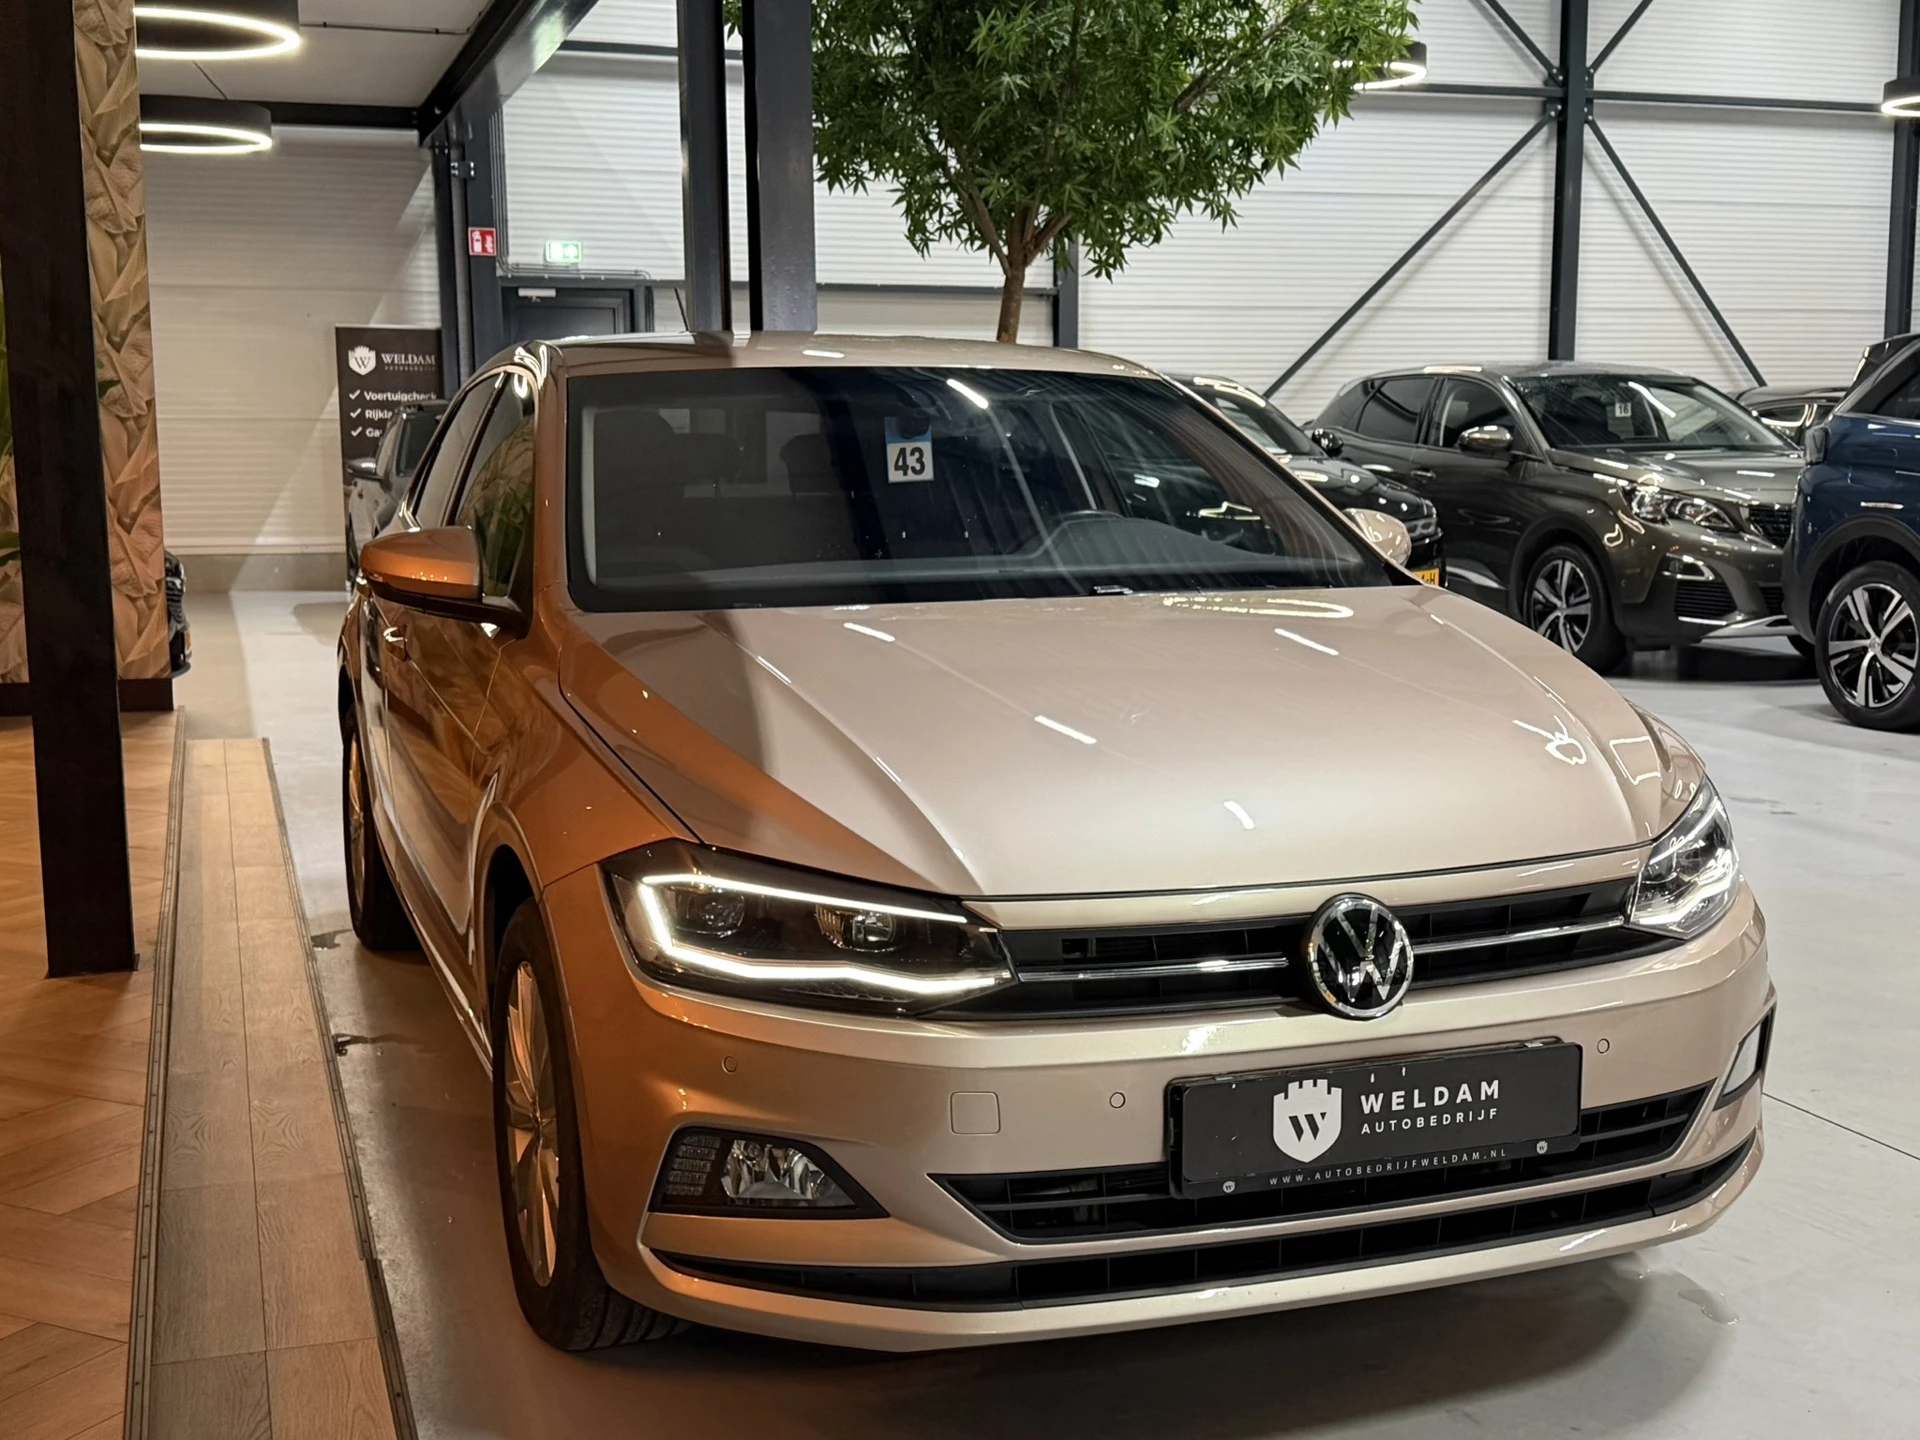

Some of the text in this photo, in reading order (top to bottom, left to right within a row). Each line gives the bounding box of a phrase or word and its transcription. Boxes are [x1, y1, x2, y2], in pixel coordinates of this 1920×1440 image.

[381, 353, 436, 366] WELDAM
[893, 446, 926, 477] 43
[1360, 1079, 1499, 1115] WELDAM
[1287, 1111, 1328, 1143] W
[1360, 1107, 1498, 1135] AUTOBEDRIJF
[1269, 1148, 1506, 1186] WWW.AUTOBEDRIJFWELDAM.NL
